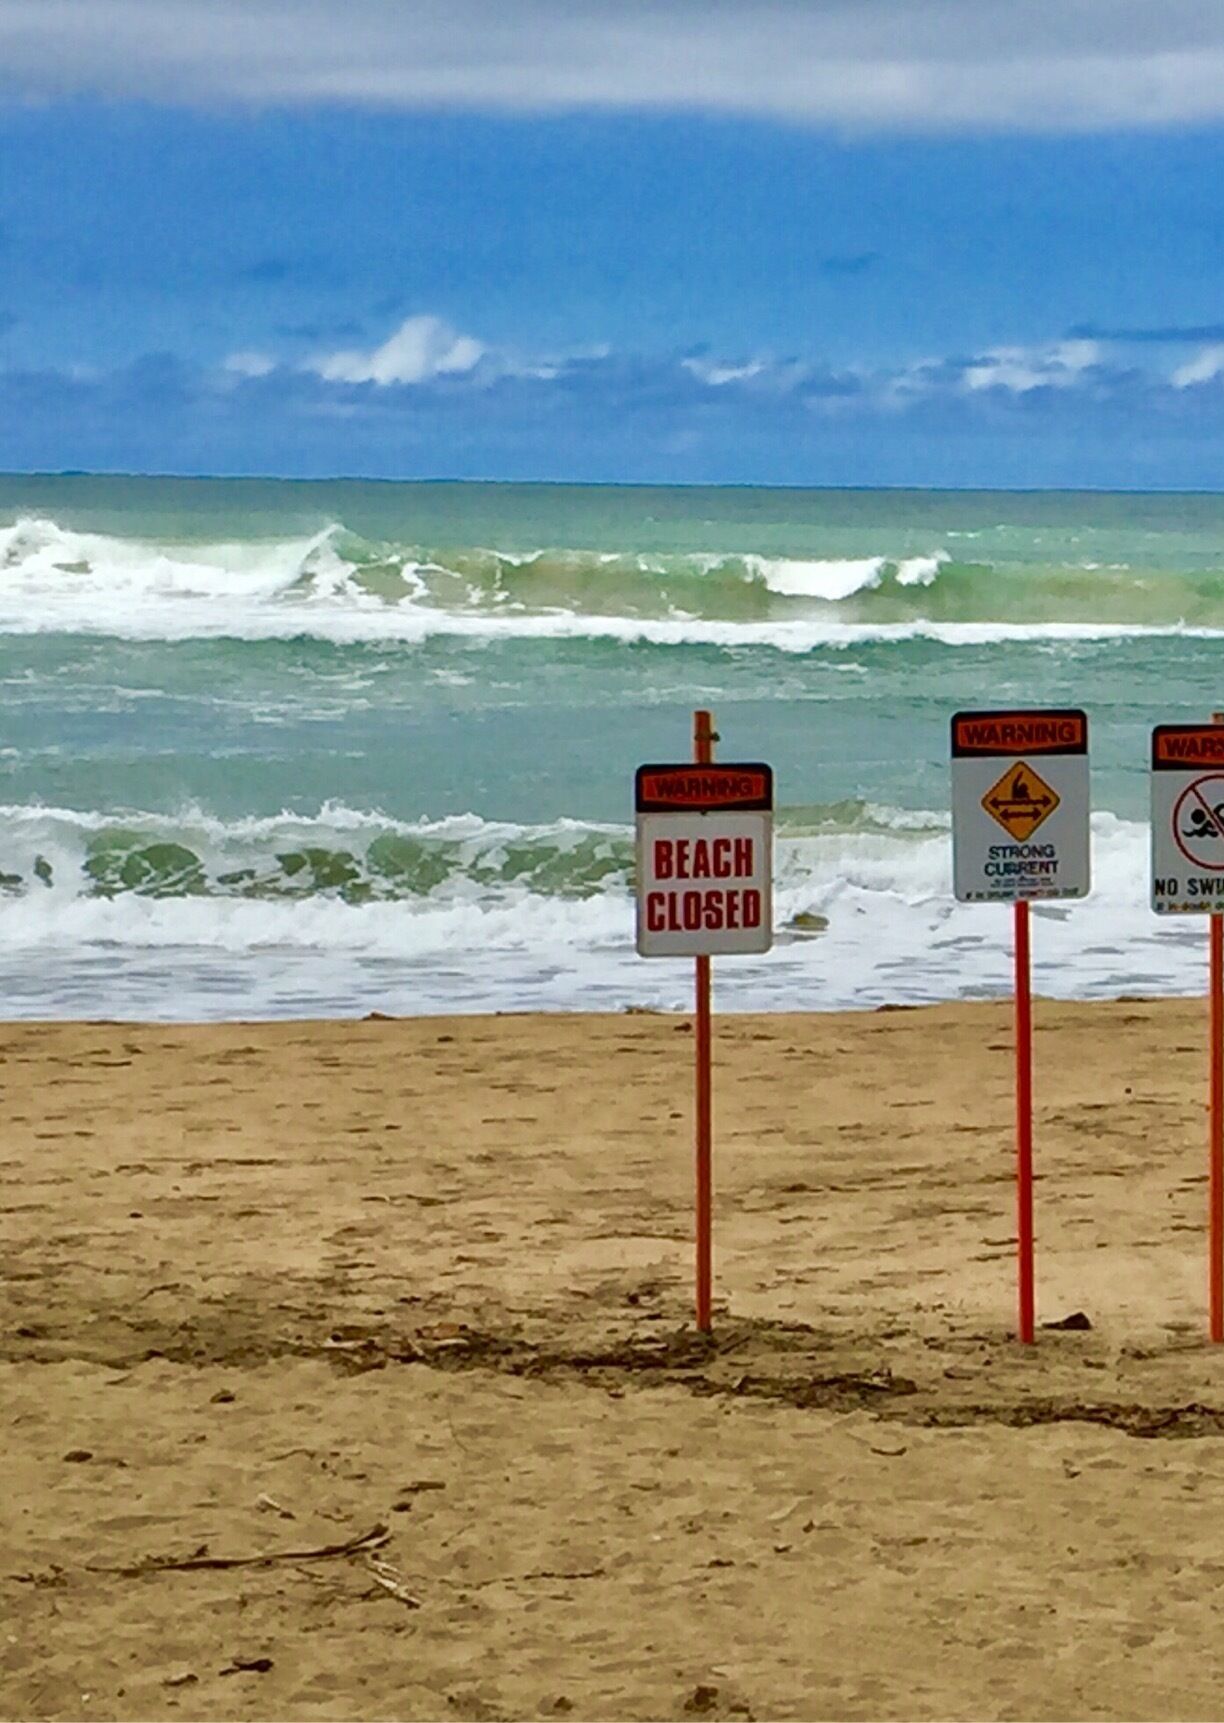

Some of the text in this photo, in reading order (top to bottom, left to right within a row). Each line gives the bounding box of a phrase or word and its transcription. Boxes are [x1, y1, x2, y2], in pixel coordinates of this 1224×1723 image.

[963, 722, 1076, 745] WARNING
[655, 775, 753, 798] WARNING
[654, 838, 753, 880] BEACH
[988, 844, 1056, 860] STRONG
[984, 860, 1059, 877] CURRENT
[1154, 878, 1178, 896] NO
[647, 889, 761, 932] CLOSED
